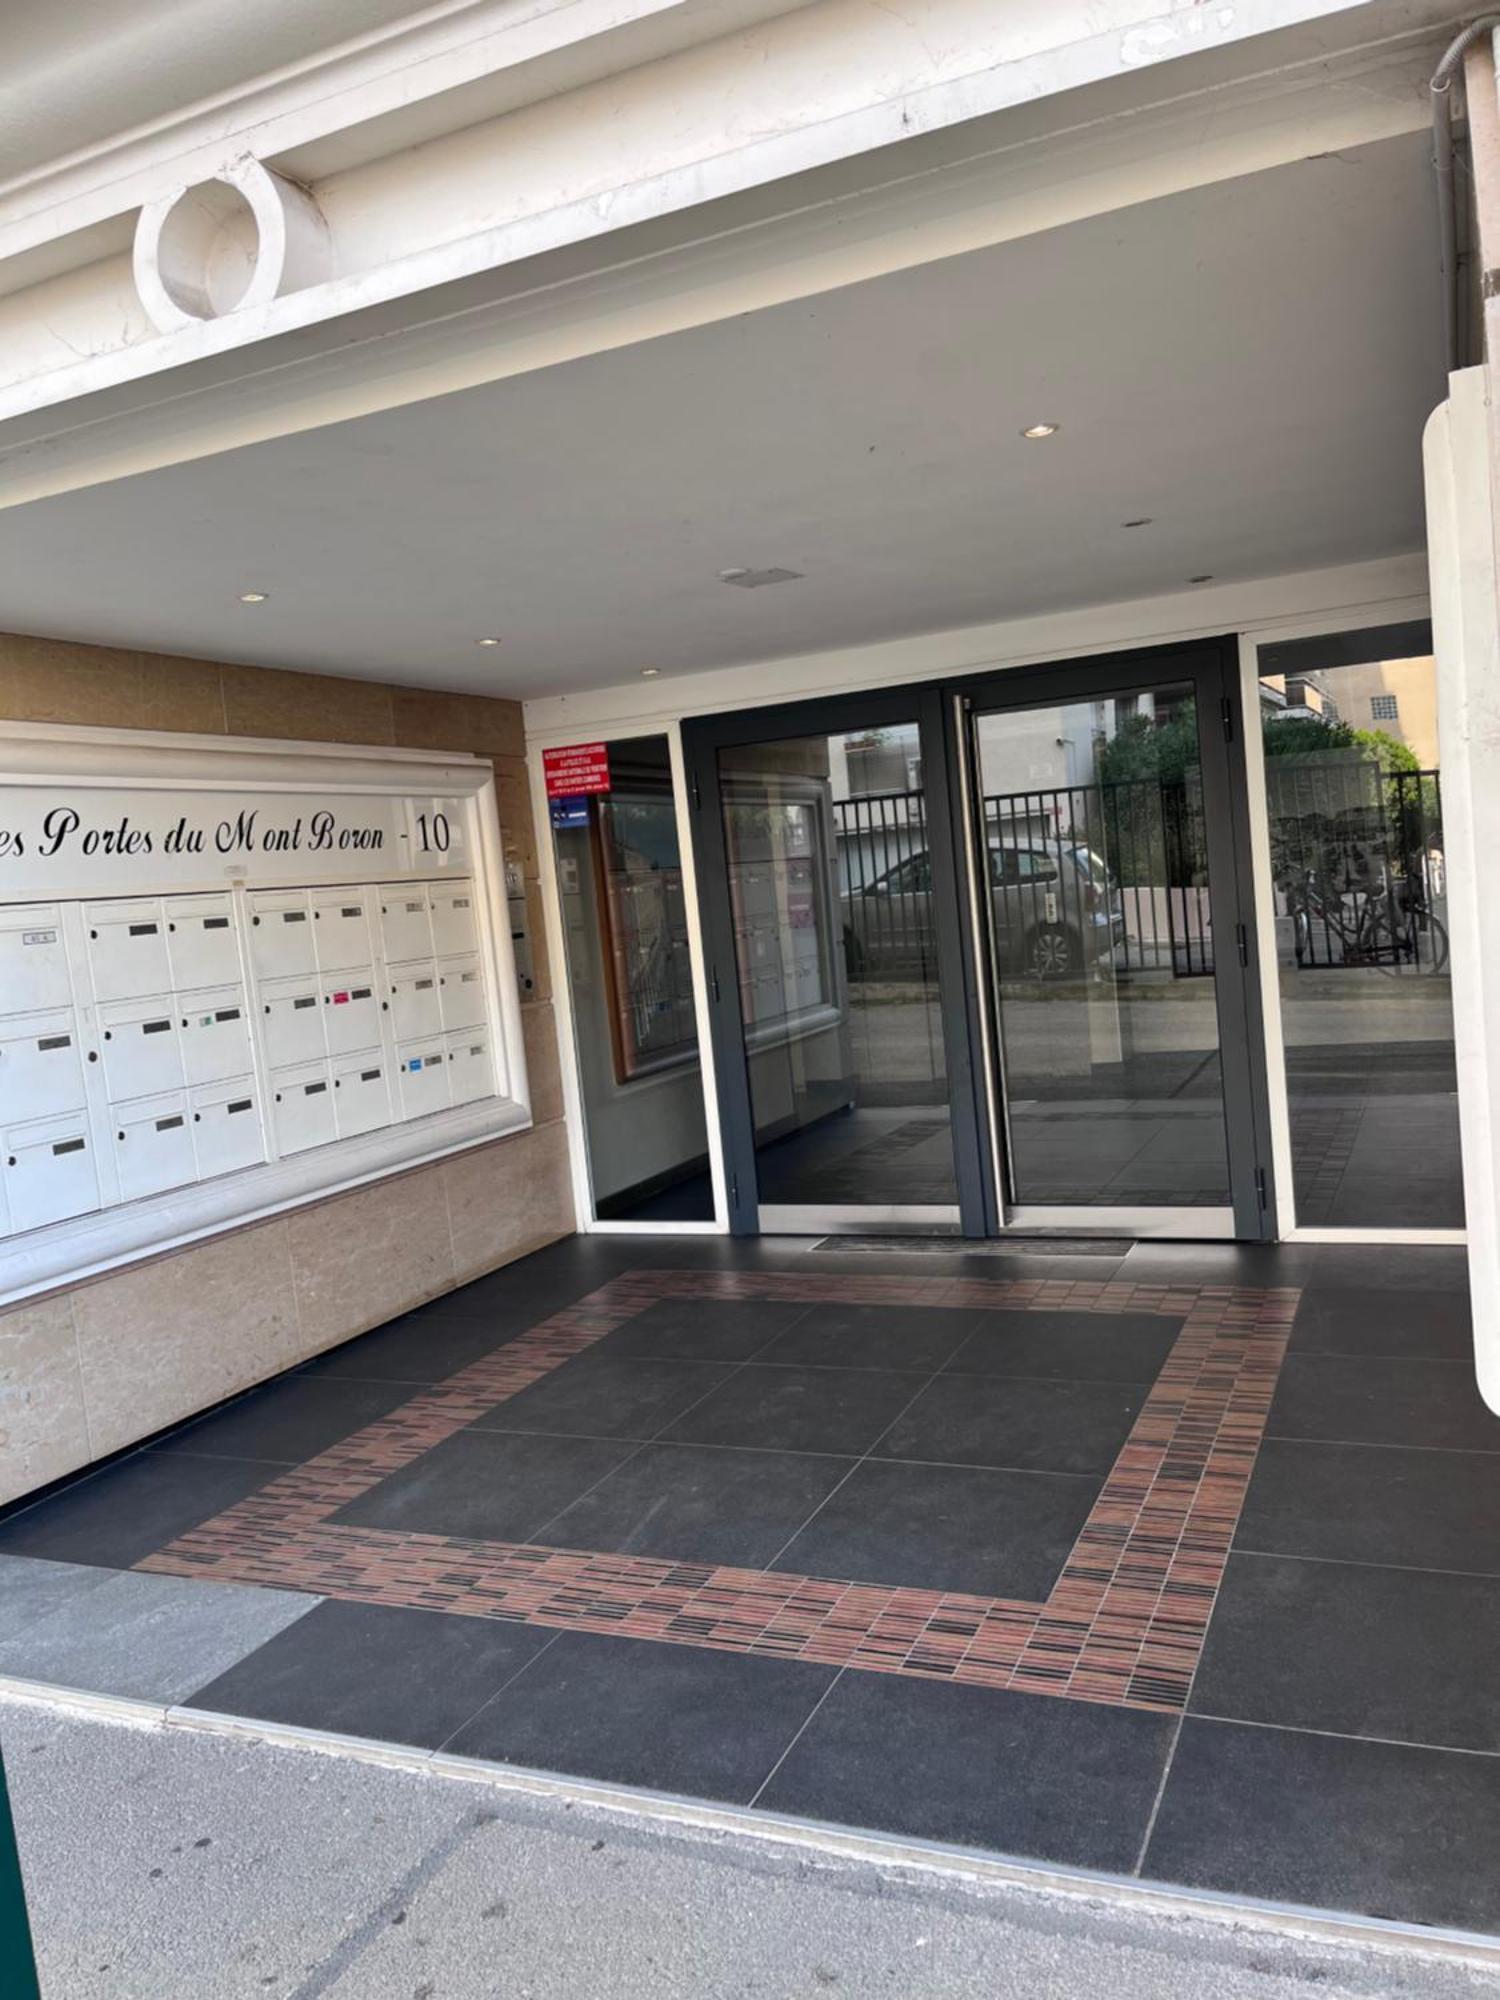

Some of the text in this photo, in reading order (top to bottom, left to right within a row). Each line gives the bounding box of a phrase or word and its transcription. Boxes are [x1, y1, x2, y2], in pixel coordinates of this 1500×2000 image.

[38, 807, 154, 857] Portes
[163, 817, 205, 855] du
[215, 809, 302, 853] Mont
[307, 809, 384, 852] Boron
[416, 812, 450, 852] 10
